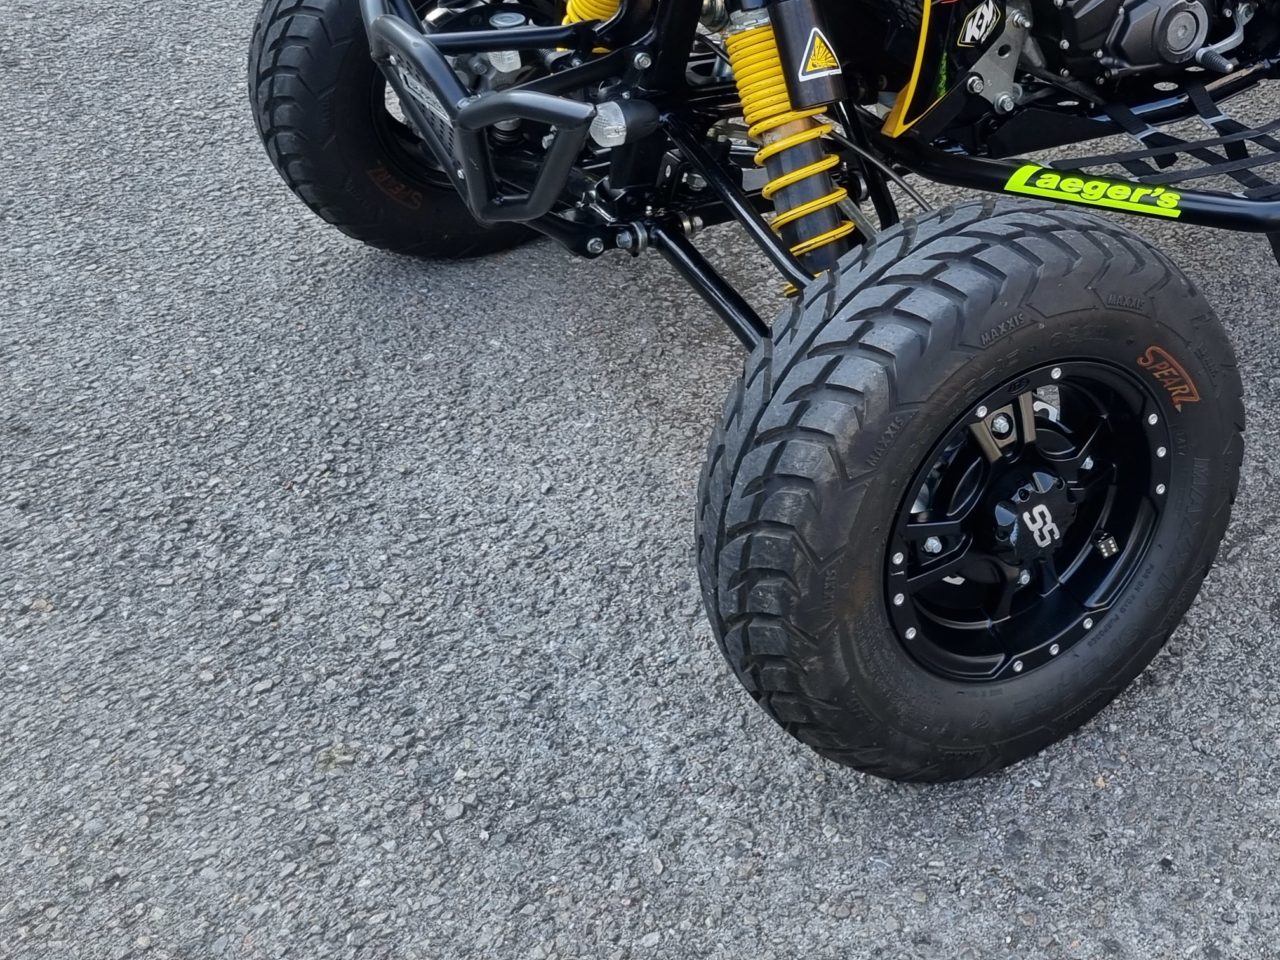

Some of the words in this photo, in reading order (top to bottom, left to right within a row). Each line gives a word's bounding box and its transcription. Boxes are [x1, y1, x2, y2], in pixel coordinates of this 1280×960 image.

[1004, 165, 1181, 218] Laeger's
[980, 311, 1025, 345] MAXXIS
[1137, 345, 1200, 413] SPEARZ
[1023, 504, 1060, 548] SS
